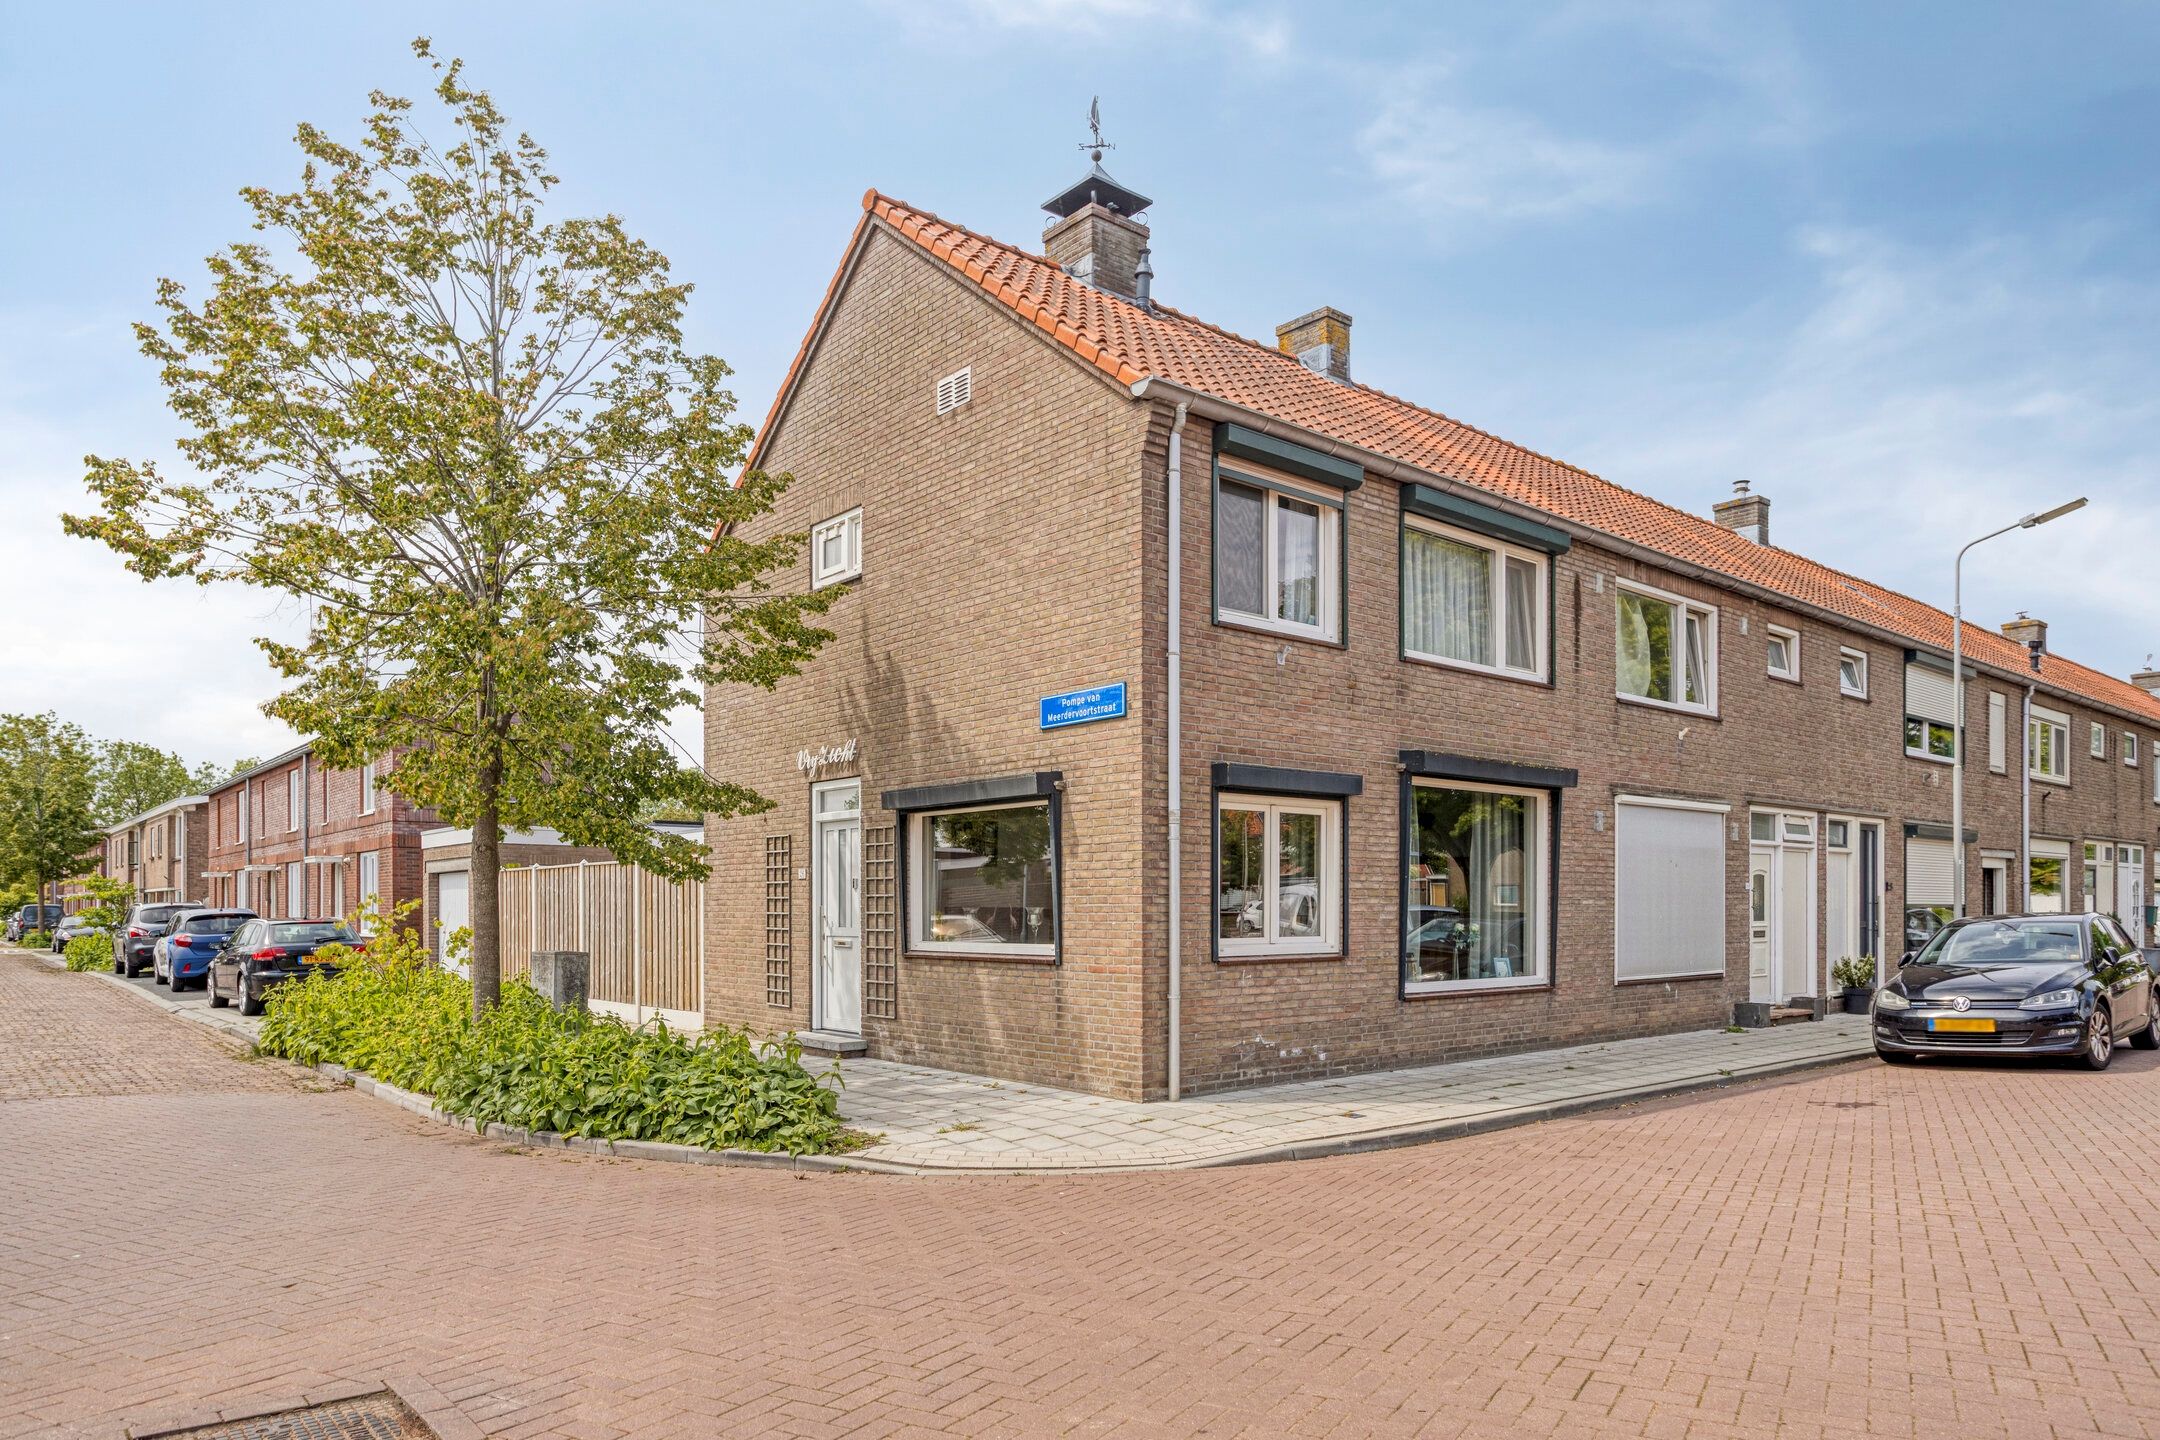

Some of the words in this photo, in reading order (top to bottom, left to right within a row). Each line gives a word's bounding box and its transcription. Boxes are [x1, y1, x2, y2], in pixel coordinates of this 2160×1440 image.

[1061, 697, 1086, 708] Pompe
[1087, 694, 1101, 703] van
[1047, 703, 1117, 722] Meerdervoortstraat
